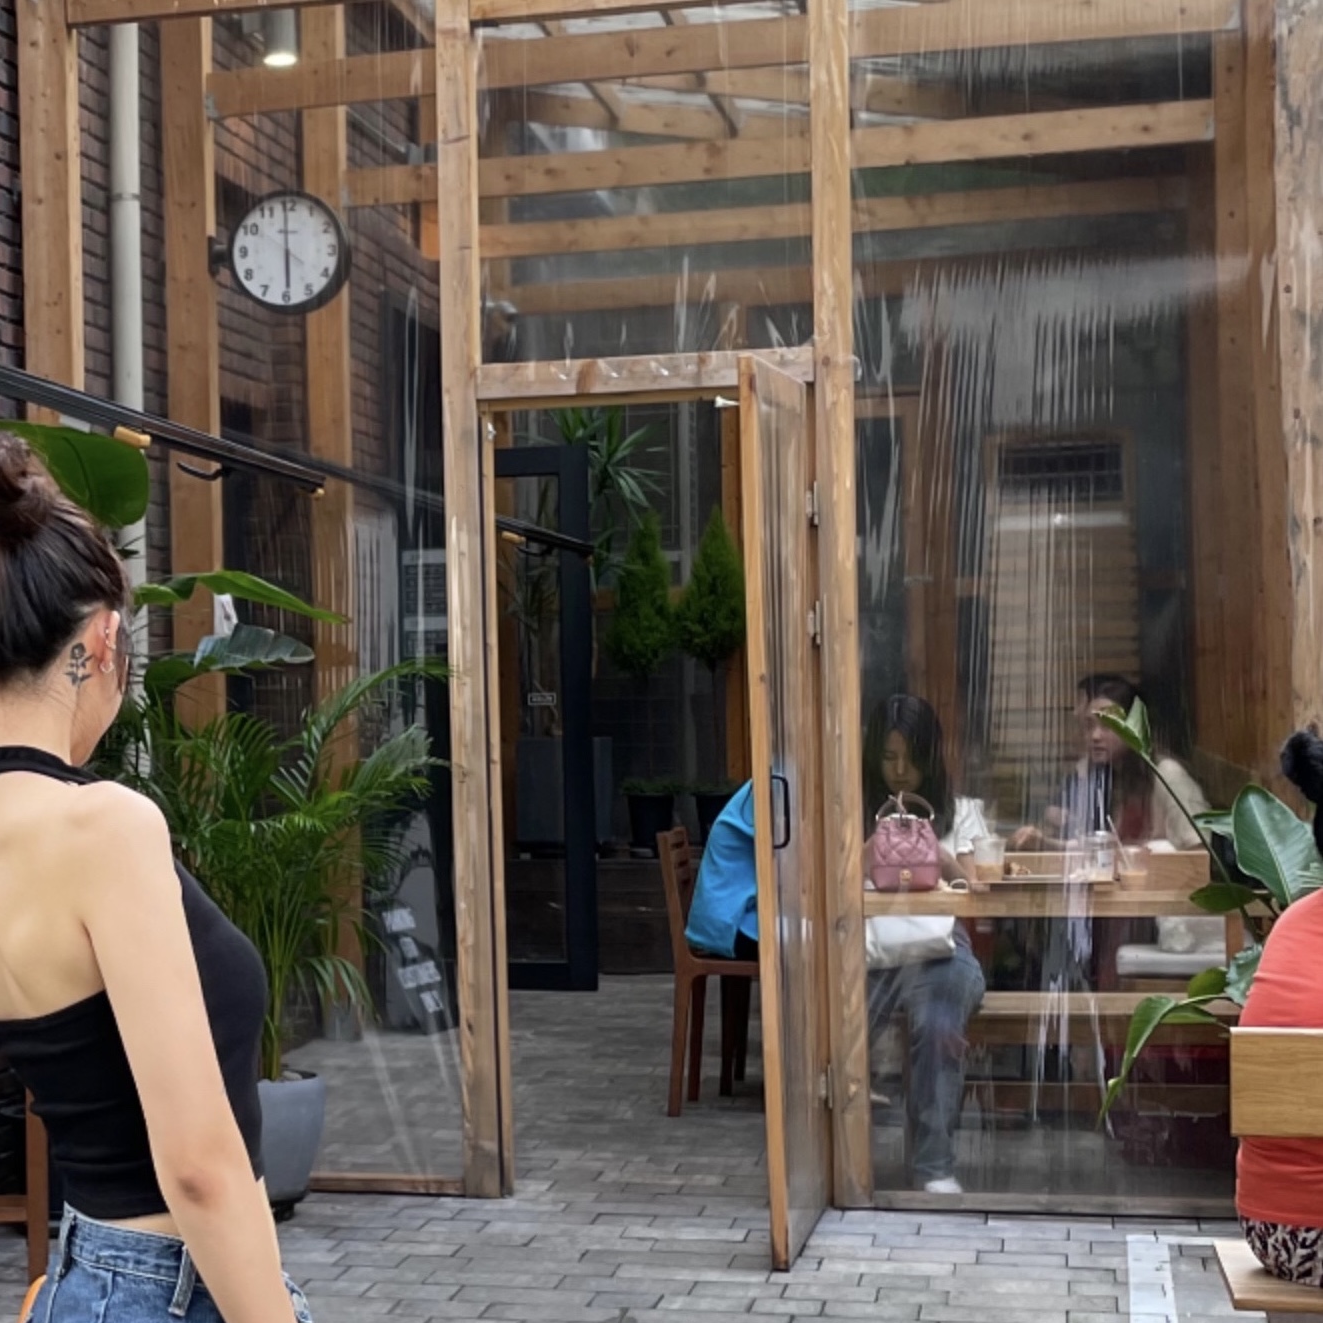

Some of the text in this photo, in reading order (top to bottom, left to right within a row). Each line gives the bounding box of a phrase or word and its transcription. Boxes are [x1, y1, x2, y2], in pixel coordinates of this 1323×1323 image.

[259, 206, 274, 218] 11
[308, 204, 314, 217] 1
[242, 222, 259, 236] 10
[322, 222, 332, 234] 2
[239, 246, 248, 259] 9
[327, 244, 337, 257] 3
[244, 268, 253, 281] 8
[320, 267, 330, 279] 4
[260, 284, 269, 297] 7
[304, 283, 314, 296] 5
[281, 290, 291, 303] 6
